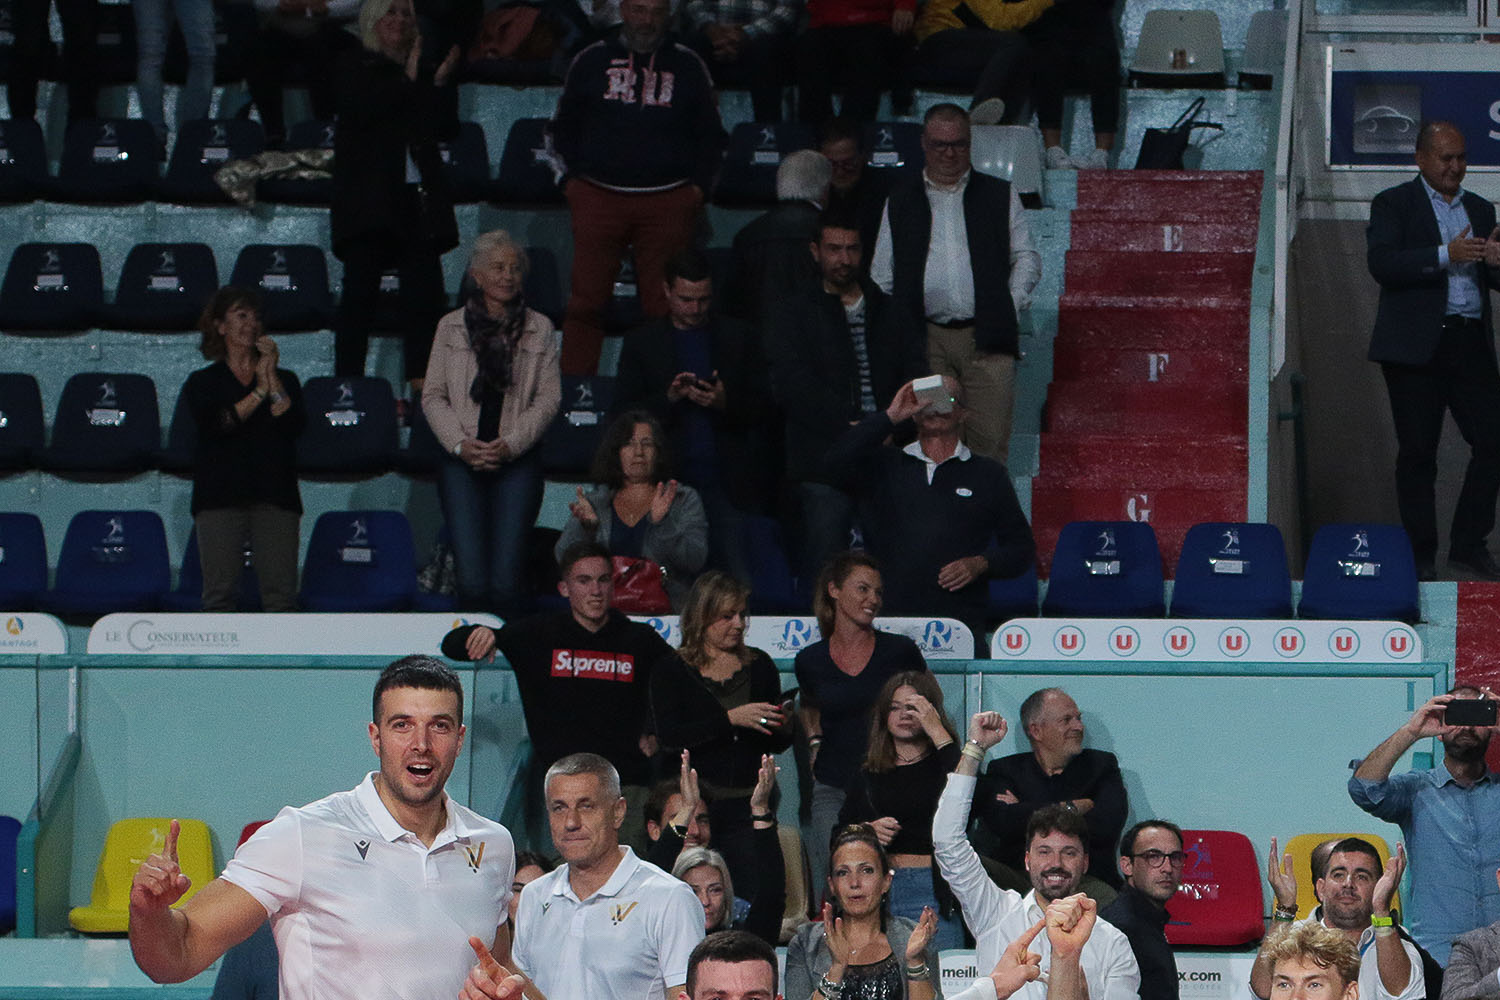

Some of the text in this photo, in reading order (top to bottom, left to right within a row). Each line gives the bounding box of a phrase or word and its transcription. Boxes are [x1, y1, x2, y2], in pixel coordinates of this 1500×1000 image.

[1162, 225, 1183, 252] E
[1147, 353, 1169, 382] F
[1127, 494, 1151, 522] G
[1006, 633, 1023, 649] U
[1061, 634, 1078, 650] U
[1116, 634, 1132, 650] U
[1171, 635, 1187, 650] U
[1226, 635, 1243, 651] U
[1281, 636, 1297, 651] U
[1336, 636, 1352, 652] U
[1390, 636, 1407, 652] U
[554, 650, 633, 676] Supreme
[942, 966, 979, 978] meill
[1177, 971, 1221, 982] x.com
